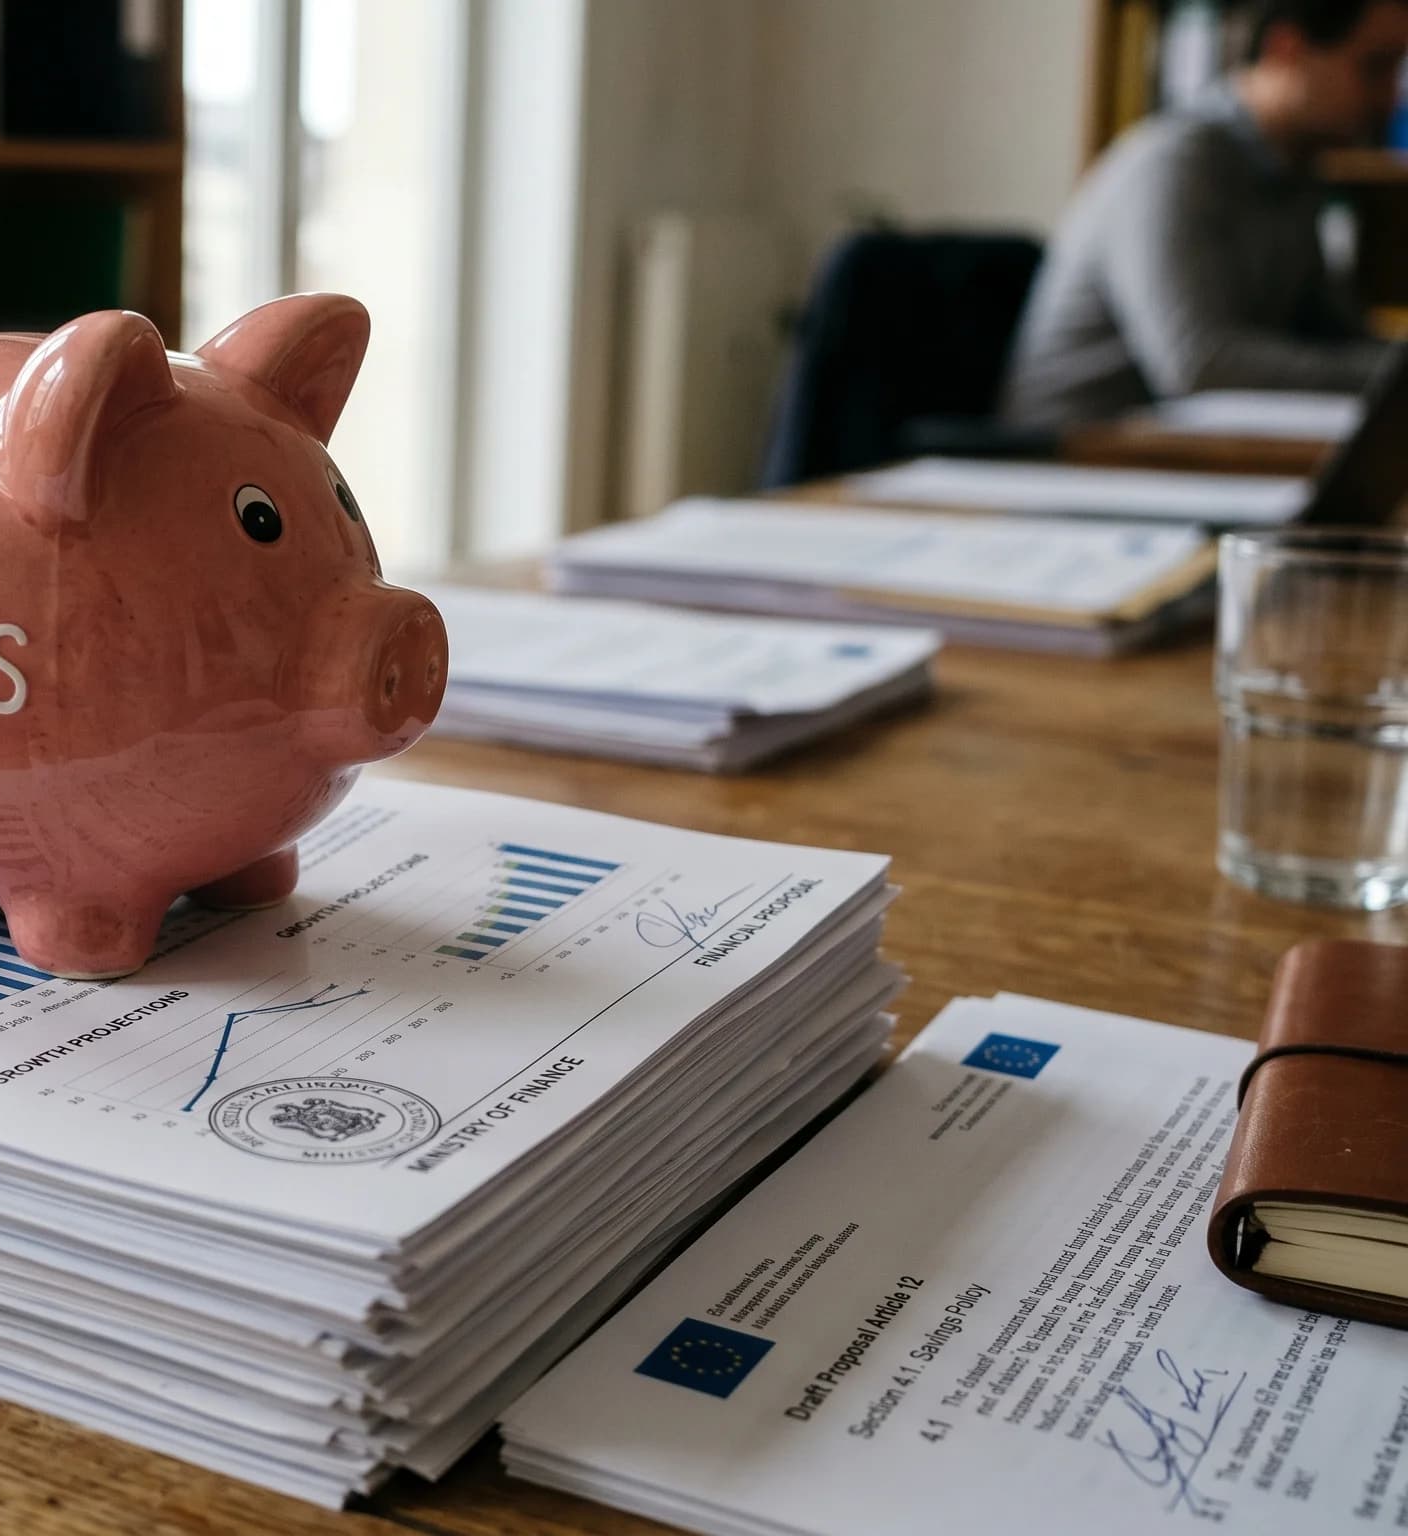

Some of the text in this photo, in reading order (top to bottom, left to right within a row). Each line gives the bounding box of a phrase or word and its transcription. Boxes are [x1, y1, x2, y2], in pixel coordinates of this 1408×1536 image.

[276, 903, 344, 939] GROWTH
[66, 989, 190, 1048] PROJECTIONS
[406, 1118, 495, 1174] MINISTRY
[485, 1102, 516, 1119] OF
[508, 1055, 585, 1103] FINANCE
[784, 1383, 833, 1422] Draft
[816, 1327, 880, 1385] Proposal
[864, 1291, 911, 1330] Article
[896, 1275, 925, 1290] 12
[909, 1315, 962, 1361] Savings
[920, 1418, 953, 1443] 4.1
